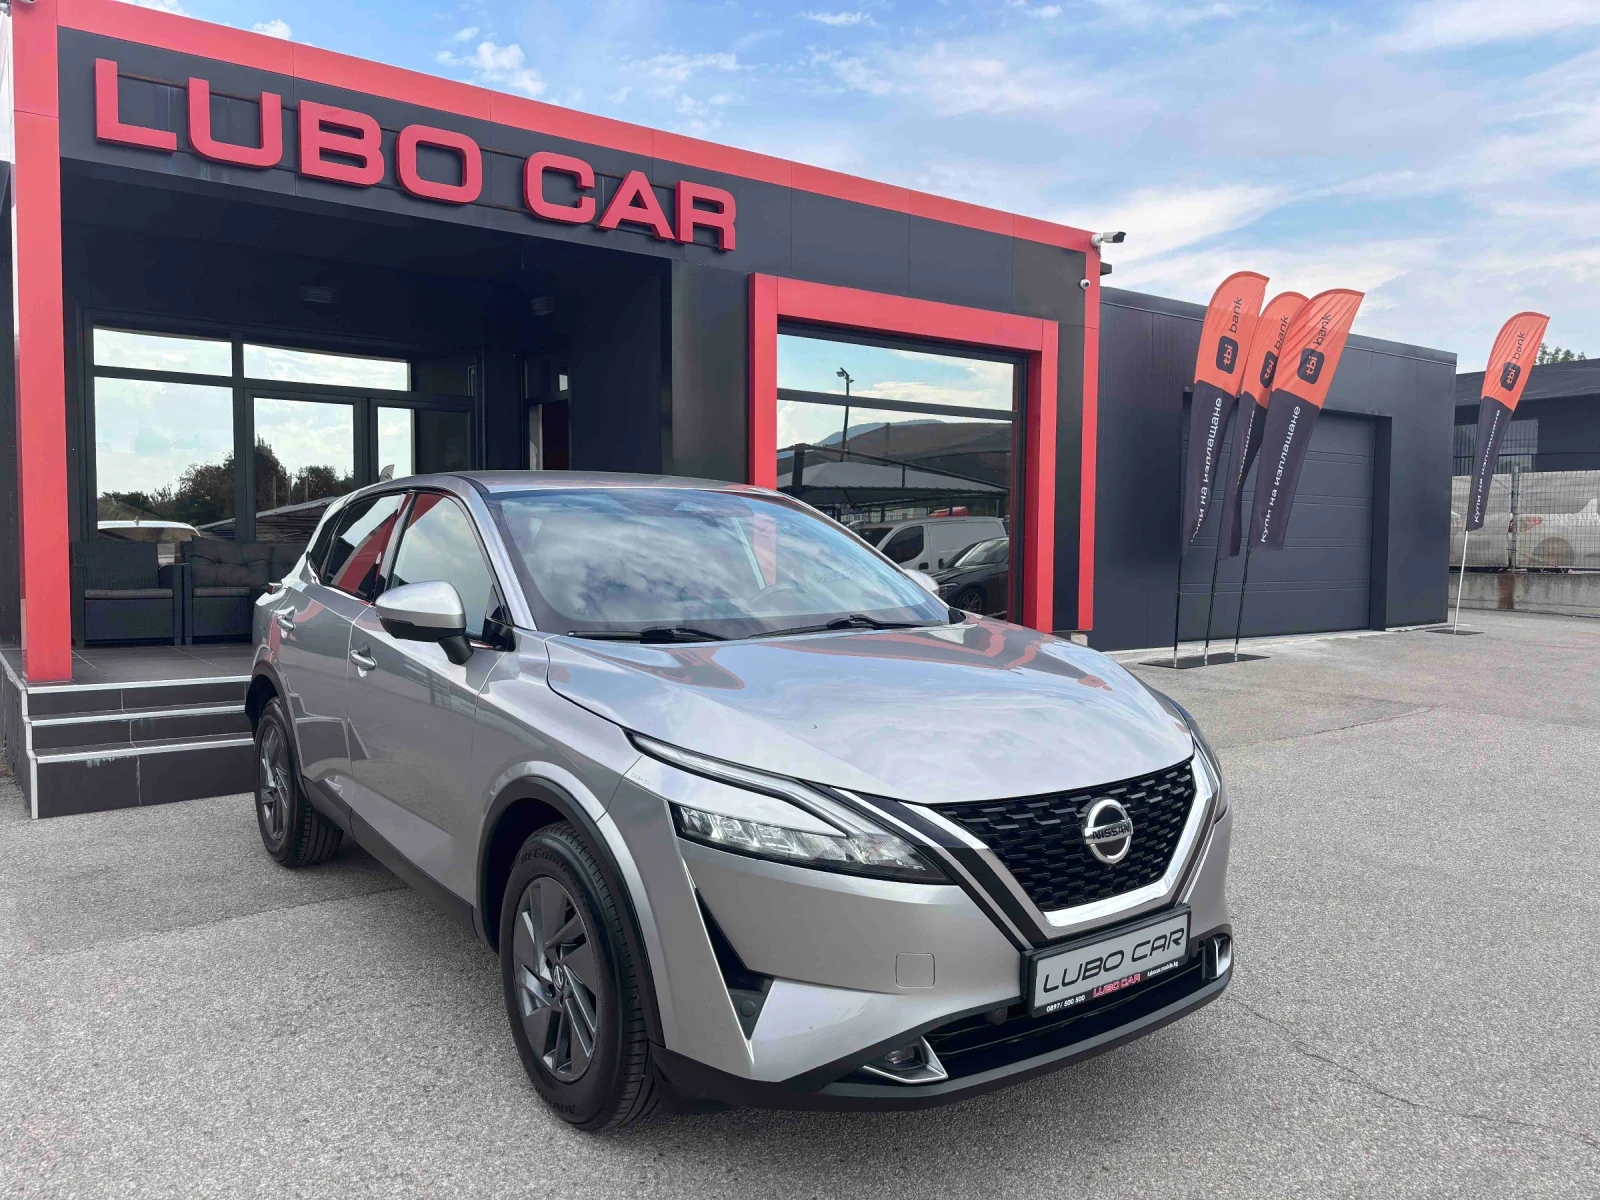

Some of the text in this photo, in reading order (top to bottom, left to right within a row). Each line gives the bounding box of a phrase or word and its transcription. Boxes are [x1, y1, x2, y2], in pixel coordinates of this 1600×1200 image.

[94, 58, 737, 252] LUBO CAR
[1223, 296, 1243, 365] tbi bank
[1274, 315, 1289, 351] bank
[1306, 312, 1332, 376] tbi bank
[1512, 331, 1526, 360] bank
[1203, 397, 1223, 482] изплащане
[1200, 486, 1209, 506] на
[1260, 405, 1302, 543] Купи на изплащане
[1092, 824, 1130, 840] NISSAN
[1043, 927, 1185, 994] LUBO CAR
[1092, 973, 1141, 998] LUBO CAR
